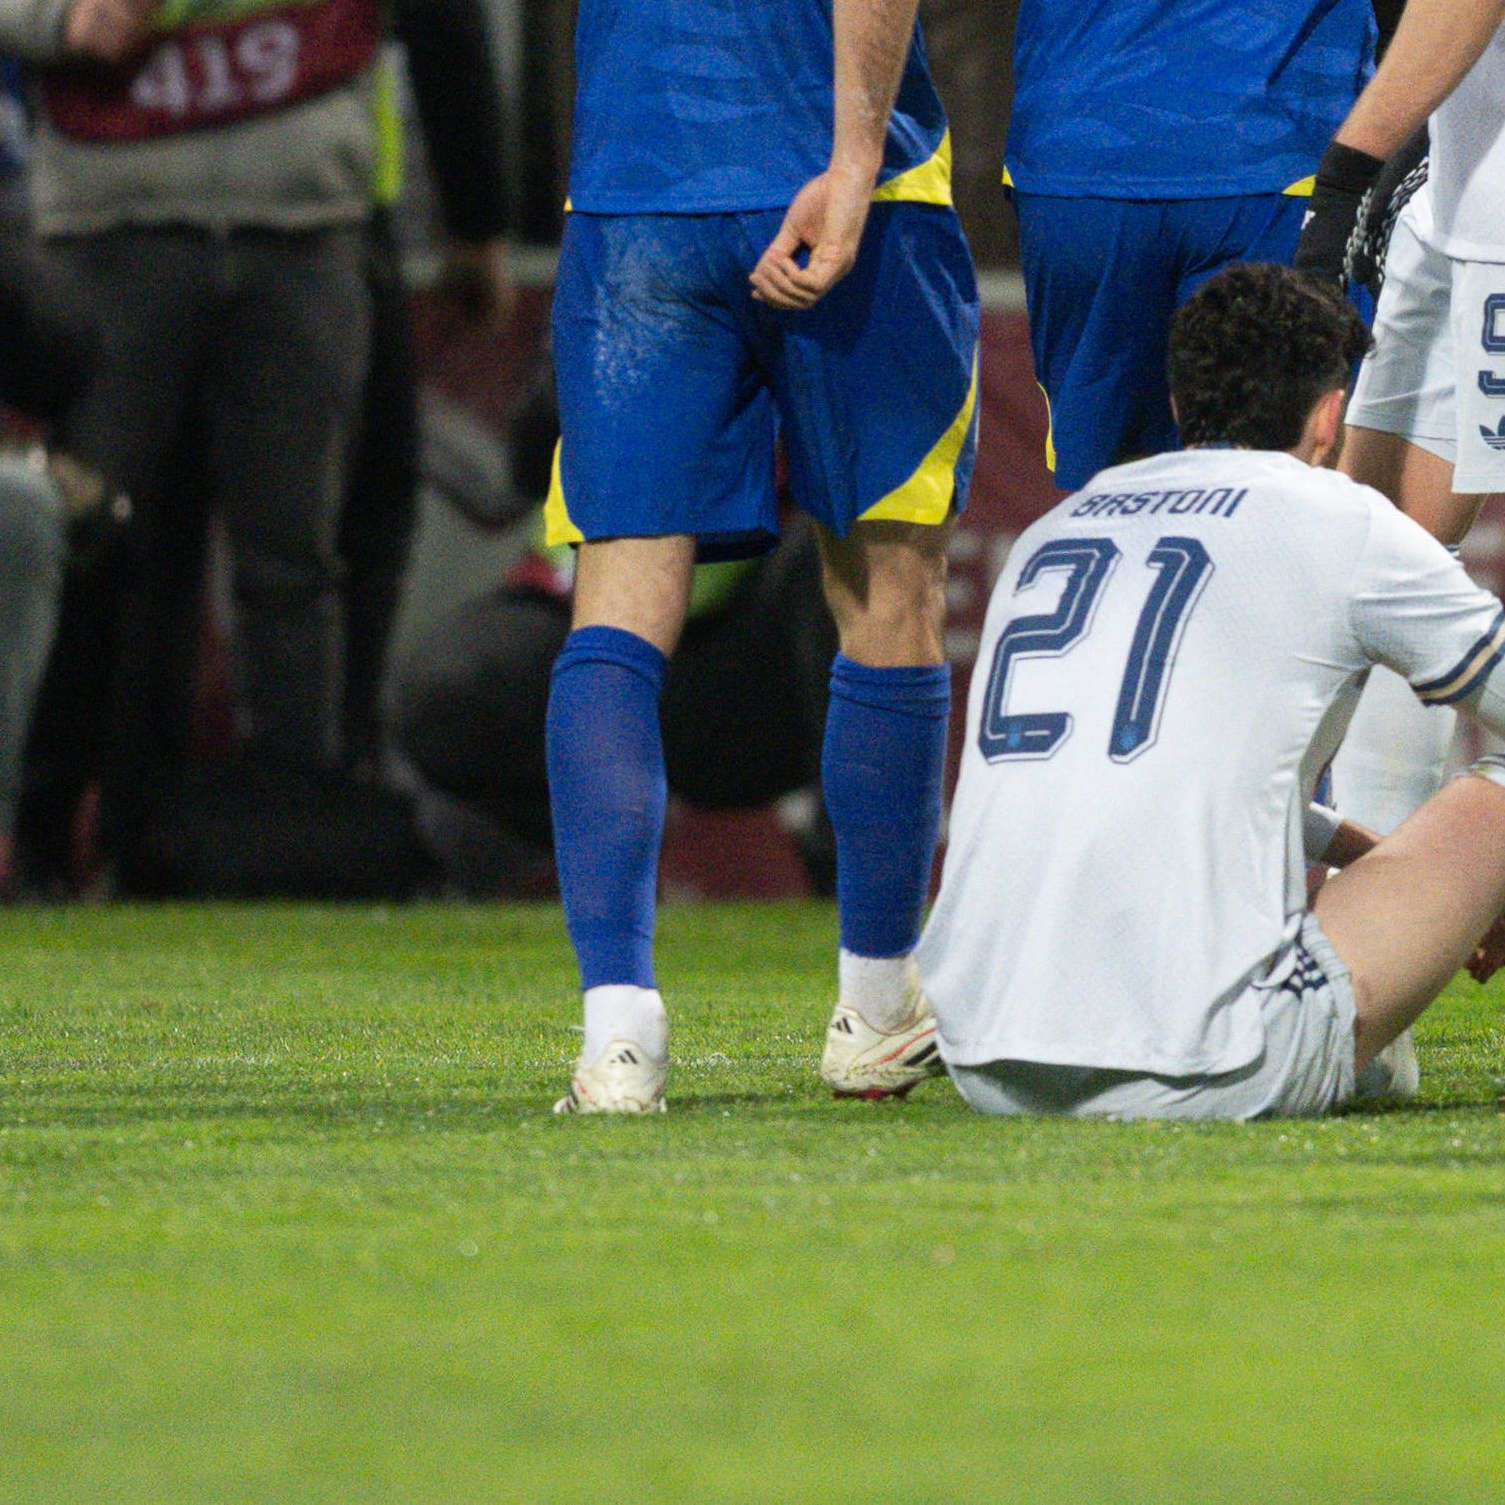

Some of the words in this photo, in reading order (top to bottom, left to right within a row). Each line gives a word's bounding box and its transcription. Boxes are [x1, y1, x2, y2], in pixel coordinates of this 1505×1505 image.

[132, 18, 300, 115] 419
[1070, 488, 1249, 518] BASTONI
[978, 536, 1215, 765] 21
